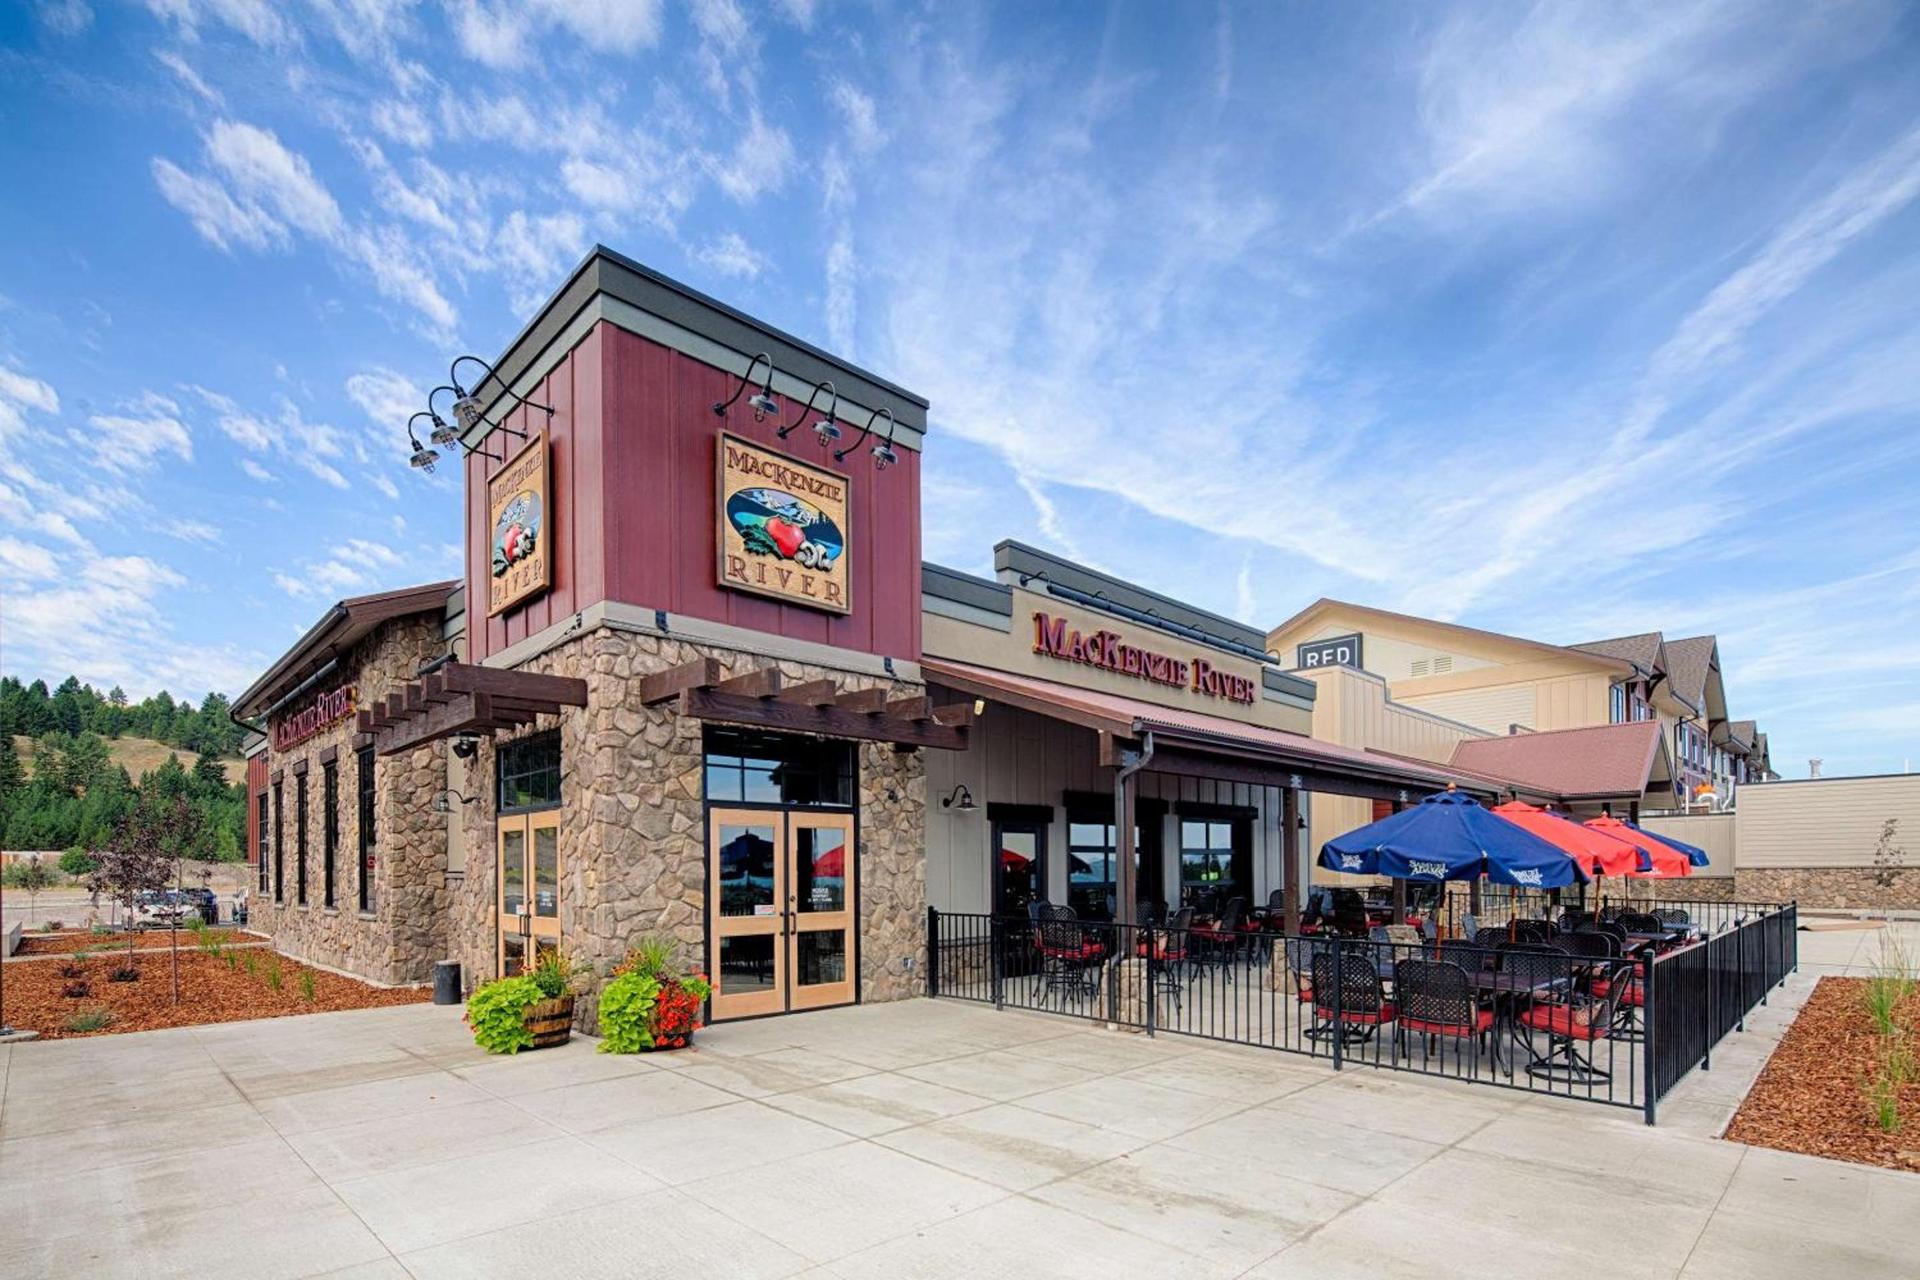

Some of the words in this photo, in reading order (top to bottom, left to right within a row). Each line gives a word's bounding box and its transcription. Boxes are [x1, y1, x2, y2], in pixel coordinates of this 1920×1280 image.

[726, 446, 843, 503] MACKENZIE
[727, 554, 843, 606] RIVER
[1191, 657, 1255, 705] RIVER
